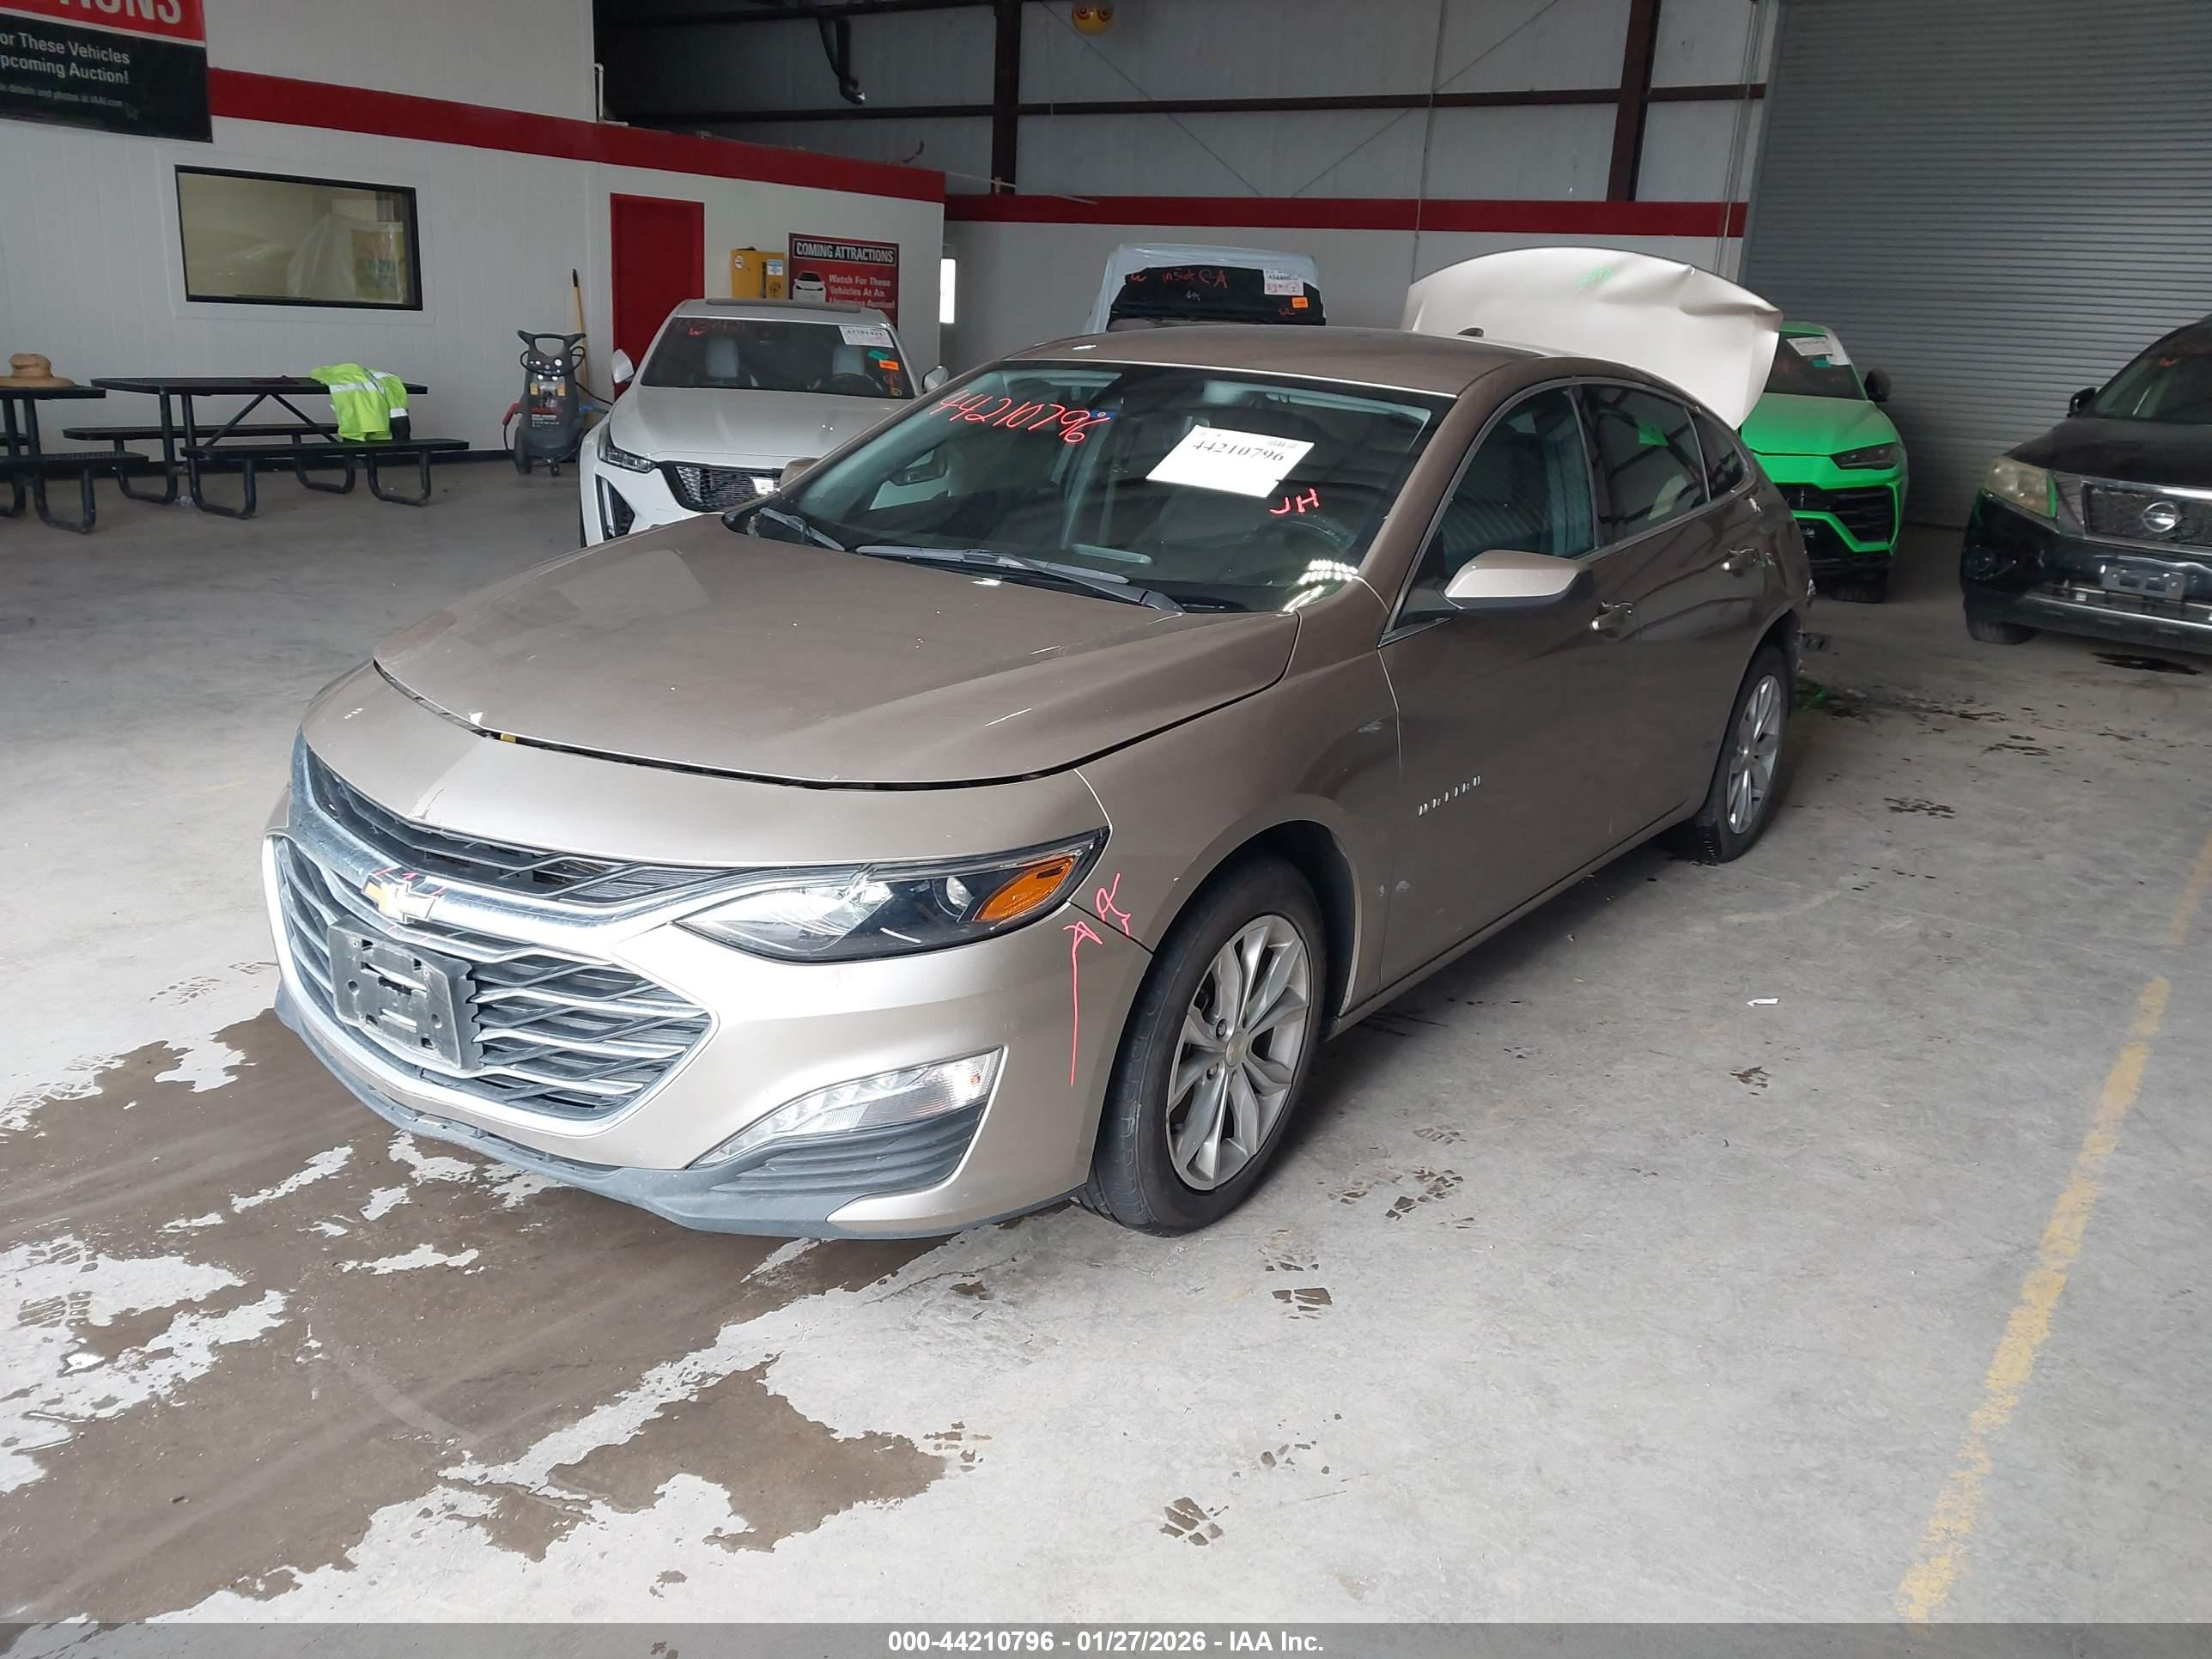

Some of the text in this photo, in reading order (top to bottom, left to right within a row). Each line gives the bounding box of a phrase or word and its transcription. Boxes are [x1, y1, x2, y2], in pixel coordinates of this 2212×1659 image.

[18, 32, 65, 54] These
[68, 40, 131, 65] Vehicles
[70, 62, 130, 85] Auction!
[796, 242, 894, 263] COMING ATTRACTIONS
[829, 274, 890, 287] Watch For These
[930, 389, 1110, 443] 44210796
[1192, 440, 1285, 462] 44210796
